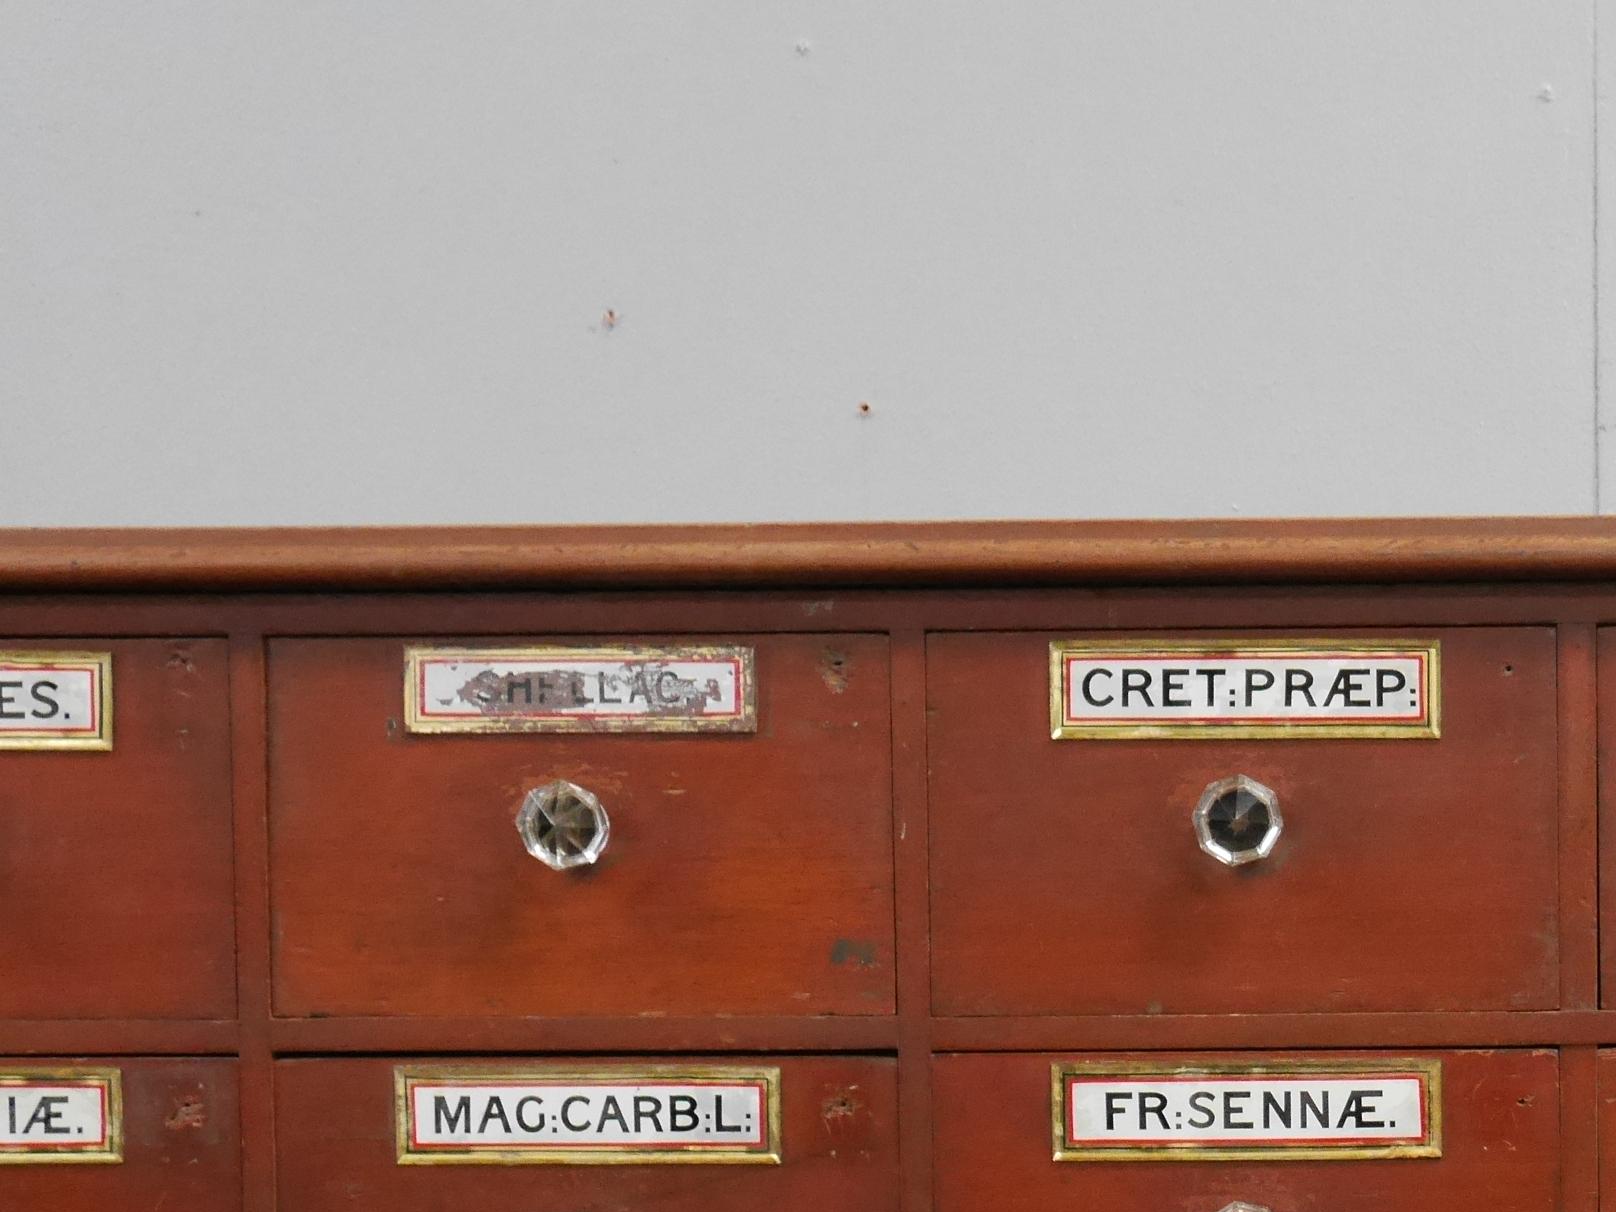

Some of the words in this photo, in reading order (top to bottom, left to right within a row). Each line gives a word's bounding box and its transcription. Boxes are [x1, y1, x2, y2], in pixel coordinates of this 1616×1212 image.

[1081, 667, 1417, 708] CRET:PRÆP:
[433, 1094, 752, 1135] MAG:CARB:L:
[1105, 1090, 1396, 1130] FR:SENNÆ.
